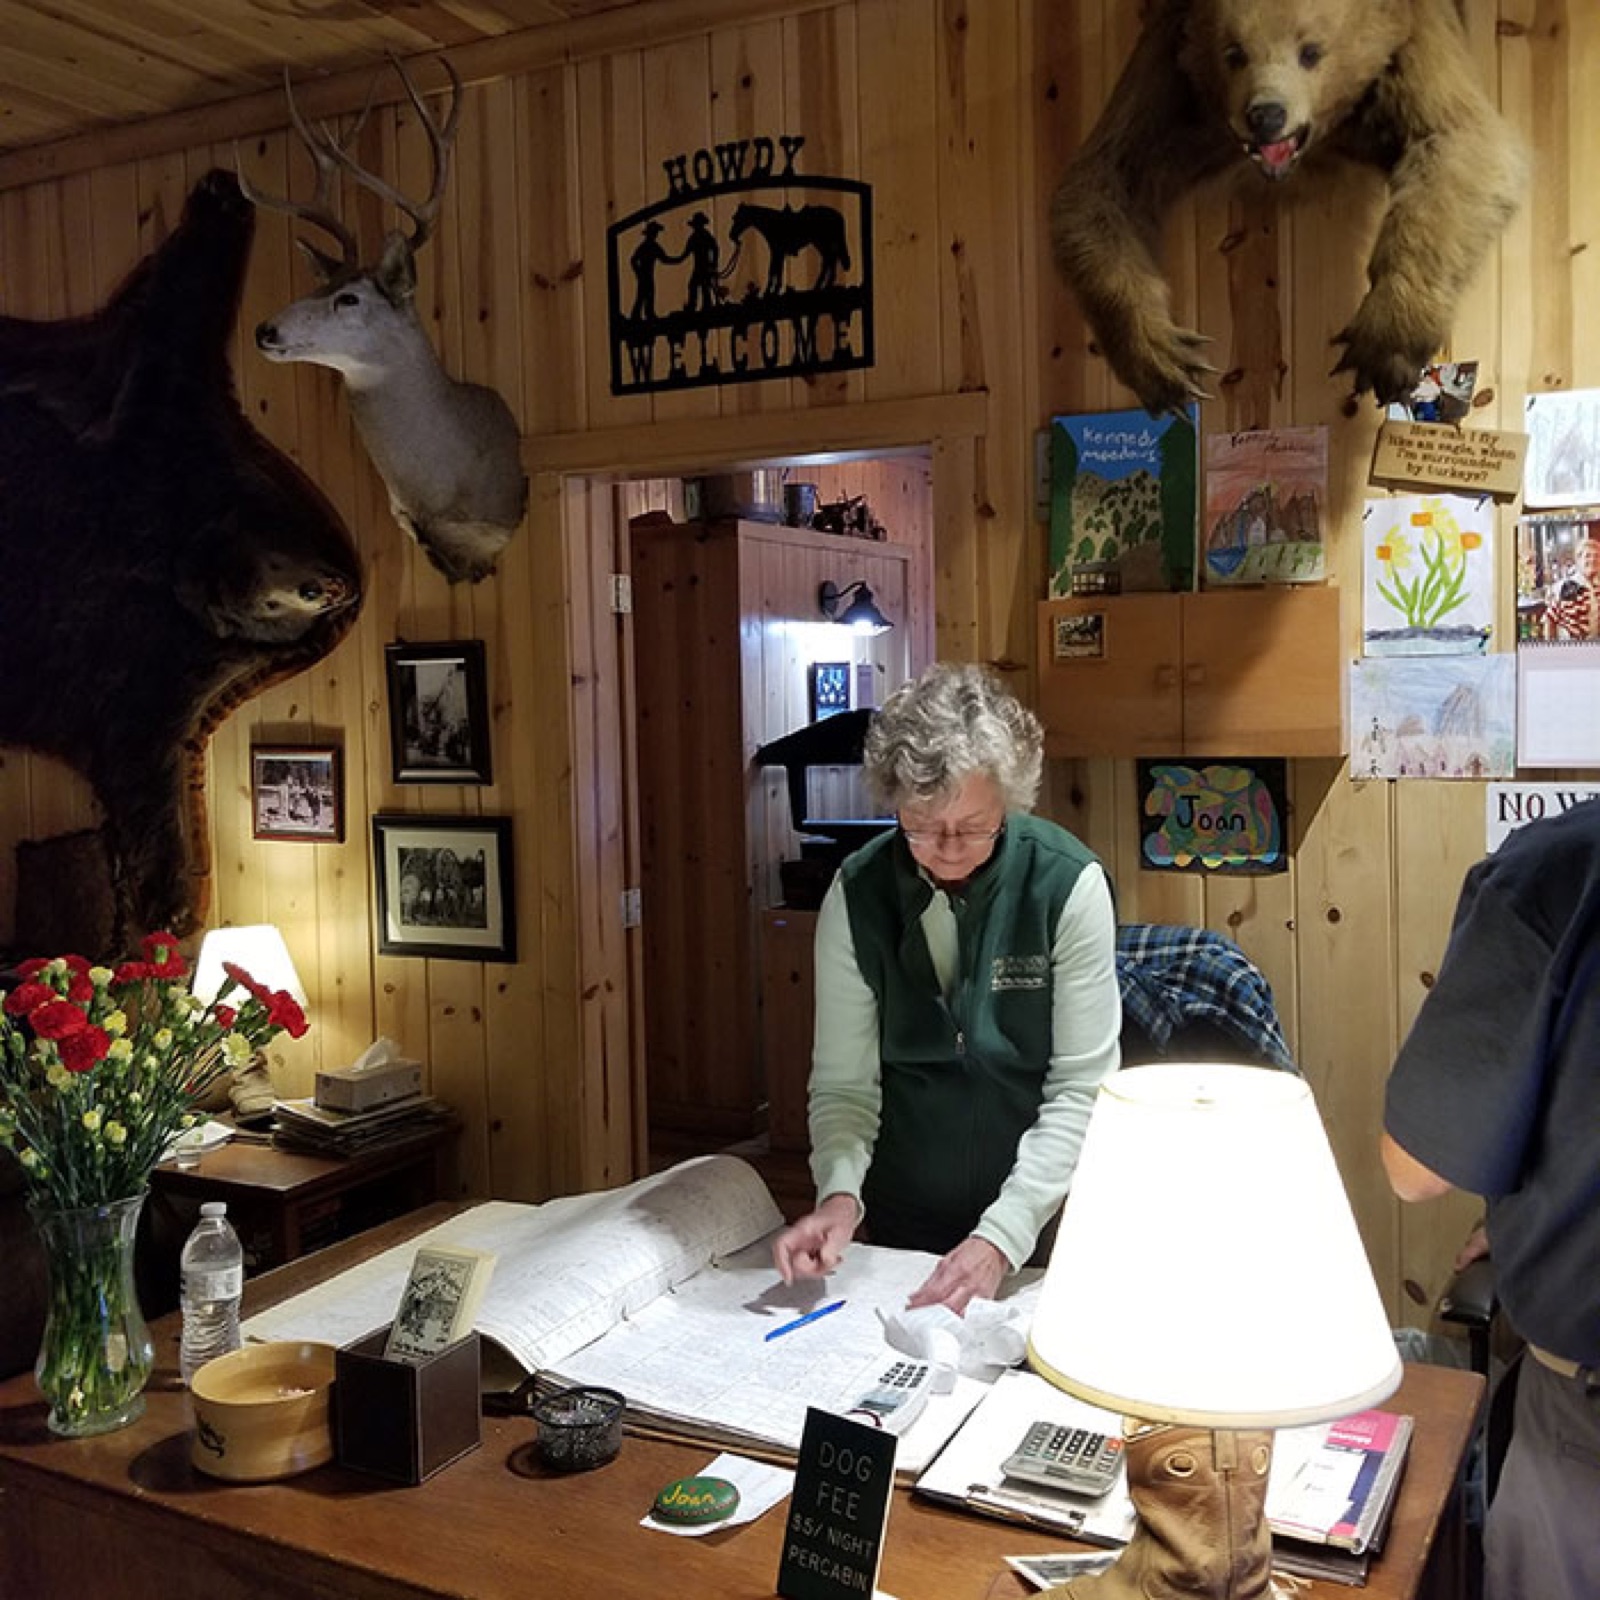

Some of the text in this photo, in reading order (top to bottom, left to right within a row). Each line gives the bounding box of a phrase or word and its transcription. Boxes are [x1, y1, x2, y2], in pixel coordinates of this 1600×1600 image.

[662, 136, 805, 199] HOWDY
[623, 312, 851, 384] WELCOME
[1417, 440, 1434, 450] an
[1406, 461, 1423, 476] by
[1176, 794, 1246, 831] Joan
[1497, 791, 1546, 822] NO
[818, 1441, 873, 1482] DOG
[661, 1484, 716, 1506] Joan
[816, 1480, 861, 1521] FEE
[827, 1525, 876, 1561] NIGHT
